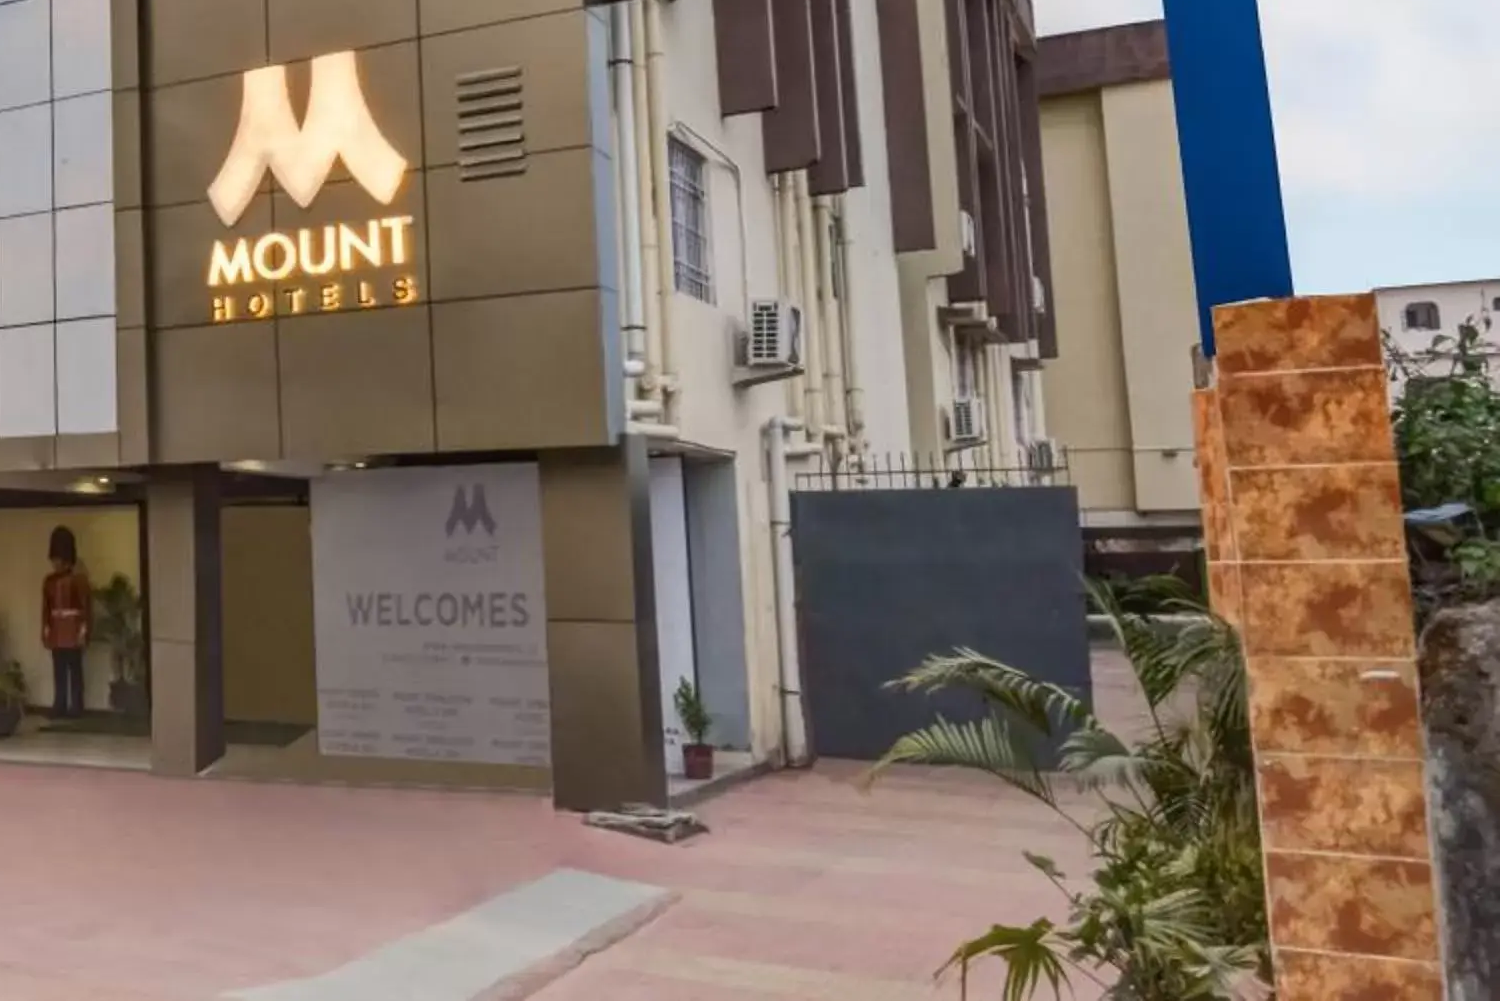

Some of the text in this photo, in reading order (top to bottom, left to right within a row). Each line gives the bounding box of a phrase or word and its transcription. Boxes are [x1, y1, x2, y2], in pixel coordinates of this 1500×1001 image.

[207, 216, 414, 286] MOUNT
[212, 278, 417, 322] HOTELS
[346, 593, 529, 627] WELCOMES
